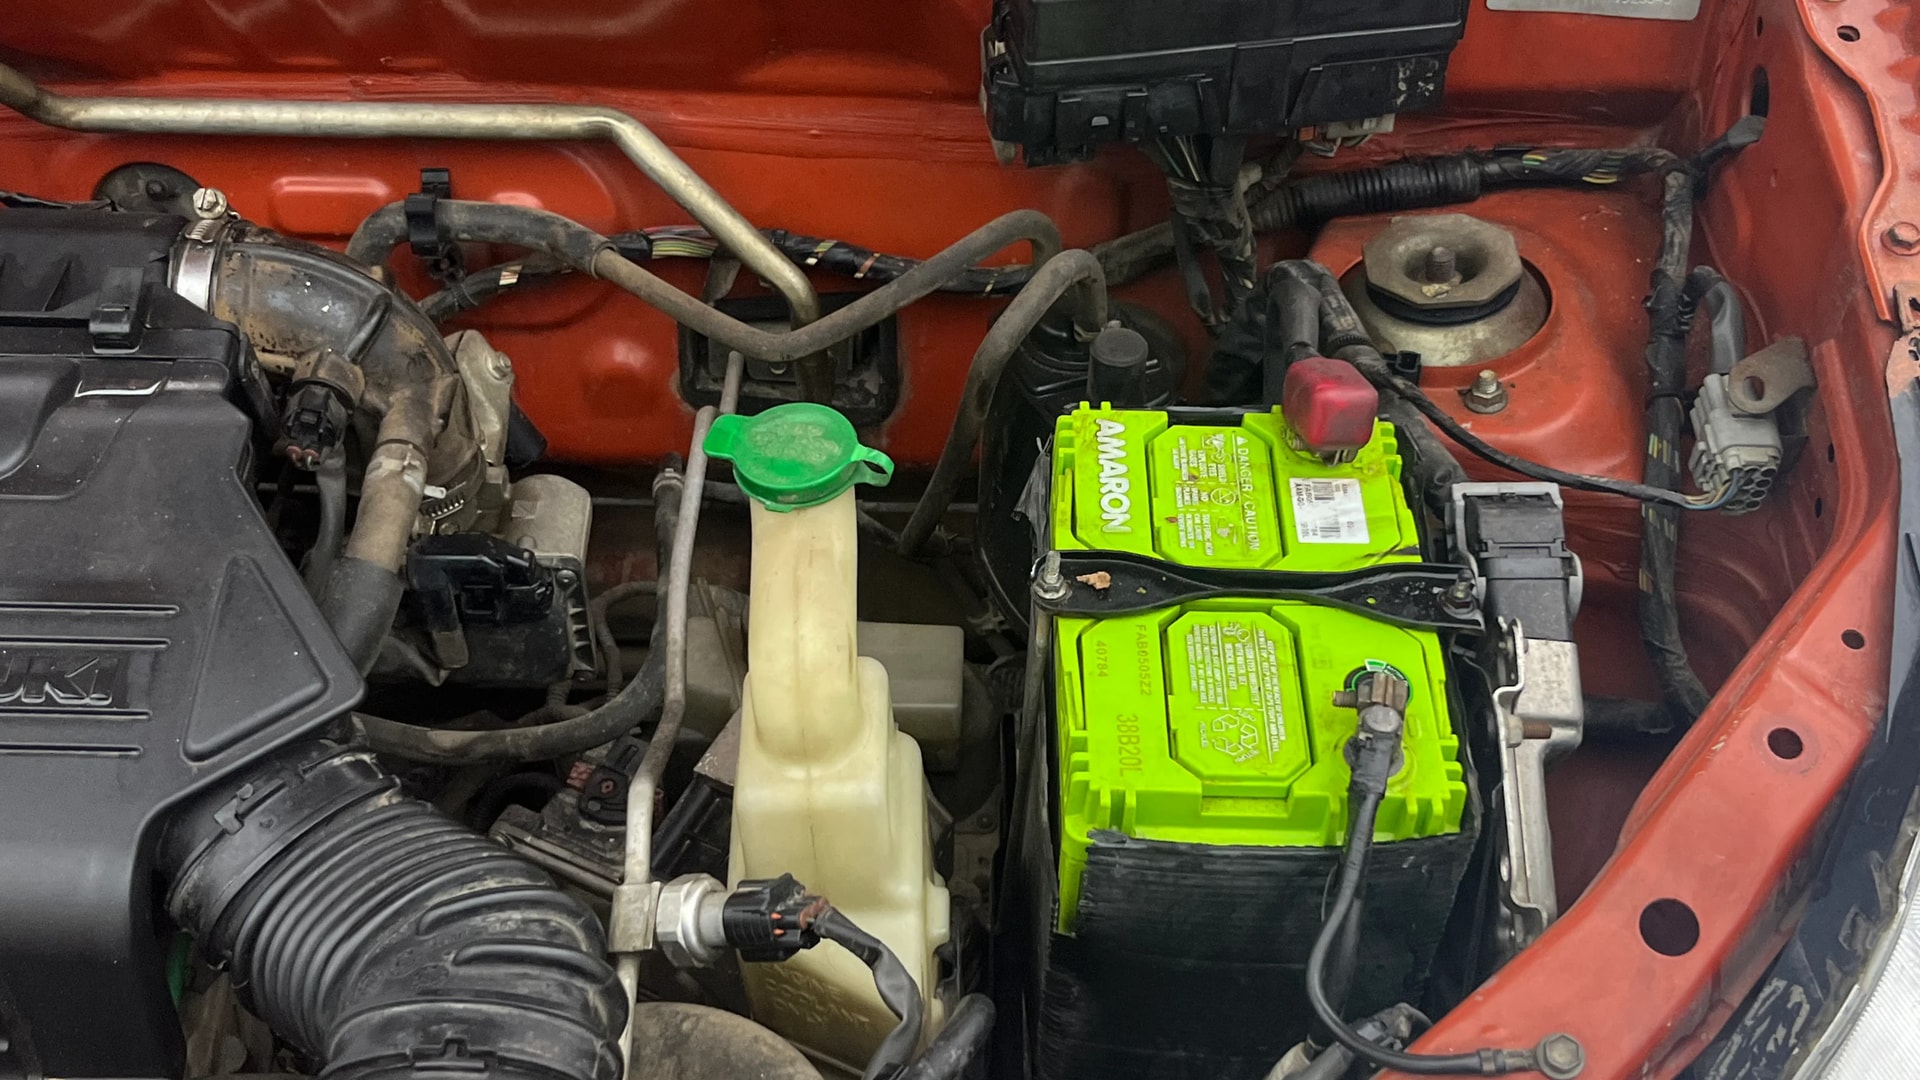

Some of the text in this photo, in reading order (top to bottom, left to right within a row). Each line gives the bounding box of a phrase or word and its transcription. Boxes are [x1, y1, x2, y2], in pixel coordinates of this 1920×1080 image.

[1096, 419, 1132, 533] AMARON
[1238, 448, 1253, 491] DANGER
[1243, 502, 1260, 550] CAUTION
[1096, 640, 1108, 677] 40784
[1116, 714, 1142, 777] 38B20L
